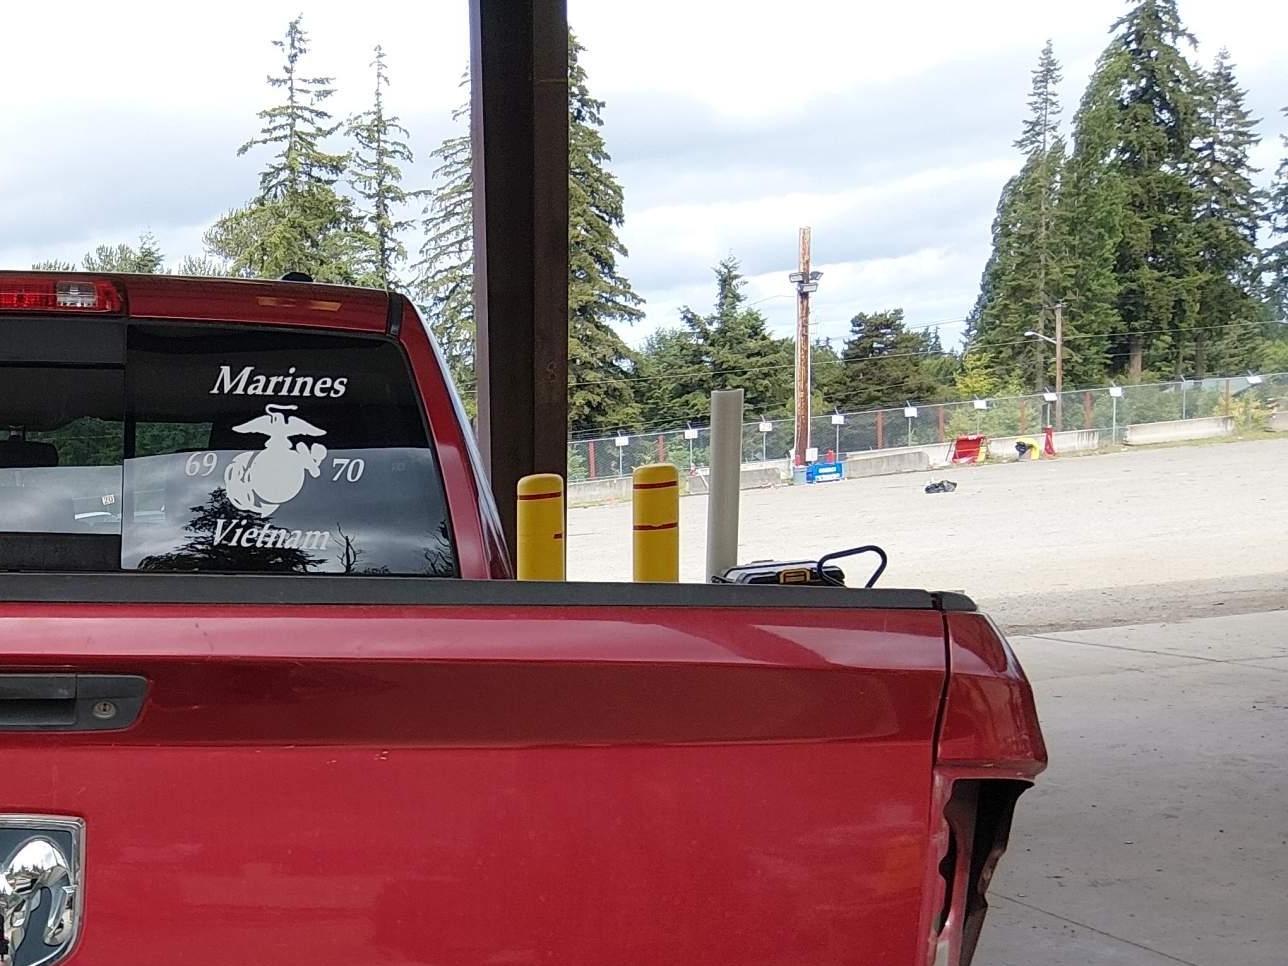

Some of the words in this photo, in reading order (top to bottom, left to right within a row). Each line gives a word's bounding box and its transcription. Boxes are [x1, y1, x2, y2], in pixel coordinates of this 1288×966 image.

[209, 365, 348, 398] Marines
[185, 452, 218, 477] 69
[331, 458, 365, 483] 70
[211, 518, 331, 550] Vietnam
